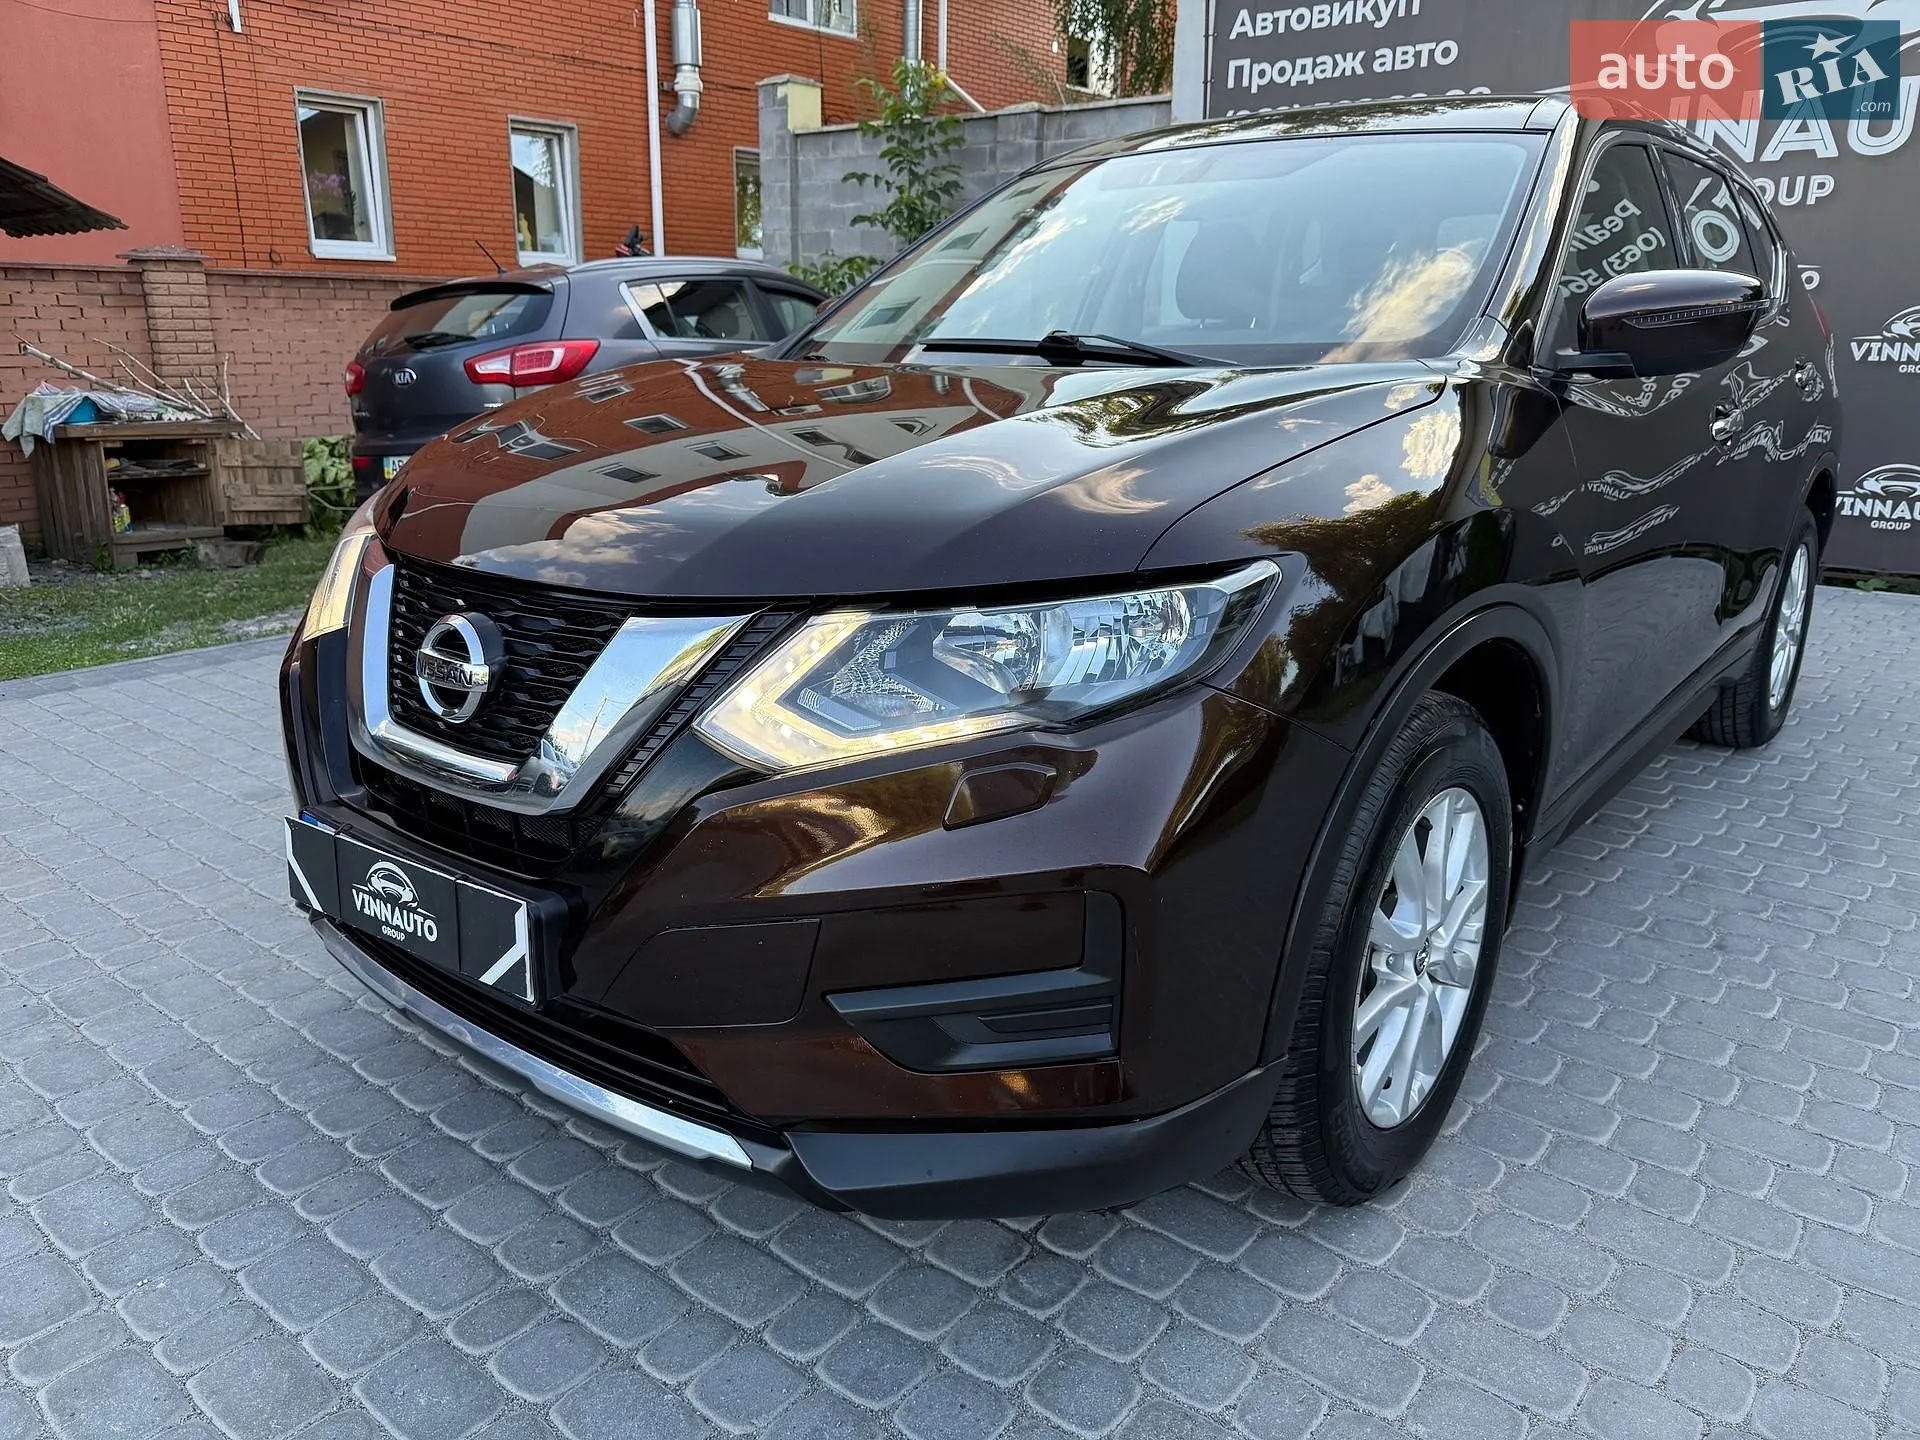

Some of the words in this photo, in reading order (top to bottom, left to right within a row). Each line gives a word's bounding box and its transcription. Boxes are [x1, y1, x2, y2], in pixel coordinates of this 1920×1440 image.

[1227, 50, 1366, 94] Продаж
[1372, 39, 1459, 73] авто
[1870, 520, 1911, 531] GROUP
[420, 653, 473, 688] NISSAN
[352, 888, 438, 942] VINNAUTO
[381, 924, 405, 942] GROUP
